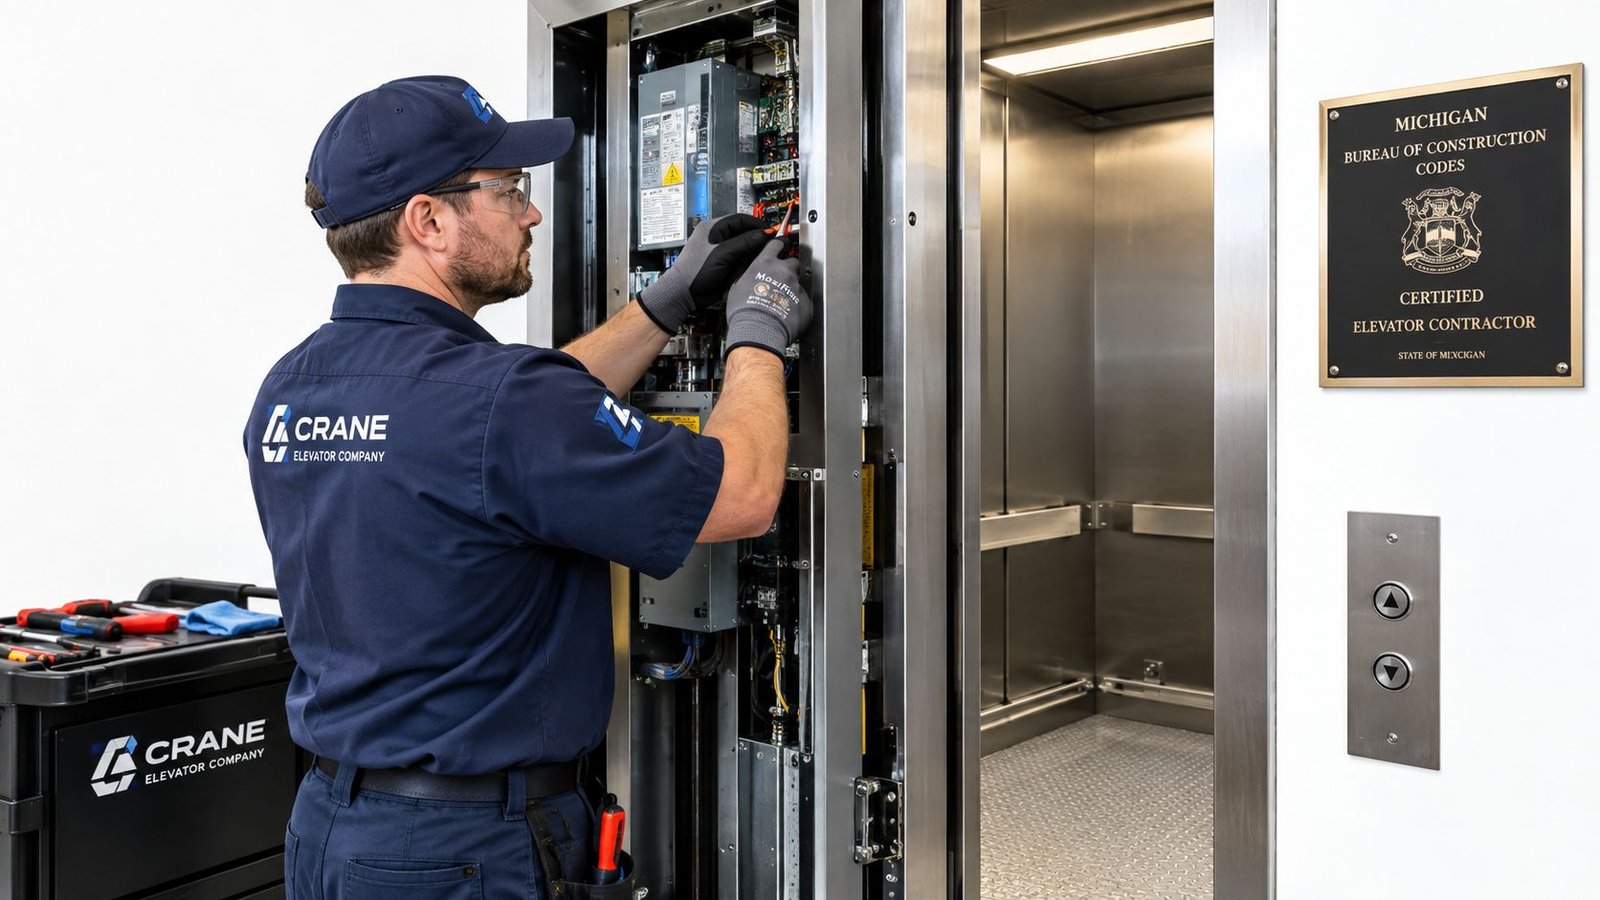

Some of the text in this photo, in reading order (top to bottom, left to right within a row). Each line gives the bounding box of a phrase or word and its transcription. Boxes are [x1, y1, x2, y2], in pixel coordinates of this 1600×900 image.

[1394, 106, 1488, 132] MICHIGAN
[1344, 128, 1547, 164] BUREAU OF CONSTRUCTION
[1416, 159, 1465, 176] CODES
[1400, 288, 1485, 306] CERTIFIED
[1353, 315, 1537, 334] ELEVATOR CONTRACTOR
[1398, 351, 1424, 360] STATE
[1425, 351, 1438, 360] OF
[294, 414, 390, 442] CRANE
[293, 450, 385, 462] ELEVATOR COMPANY
[145, 718, 266, 765] CRANE
[145, 748, 265, 785] ELEVATOR COMPANY
